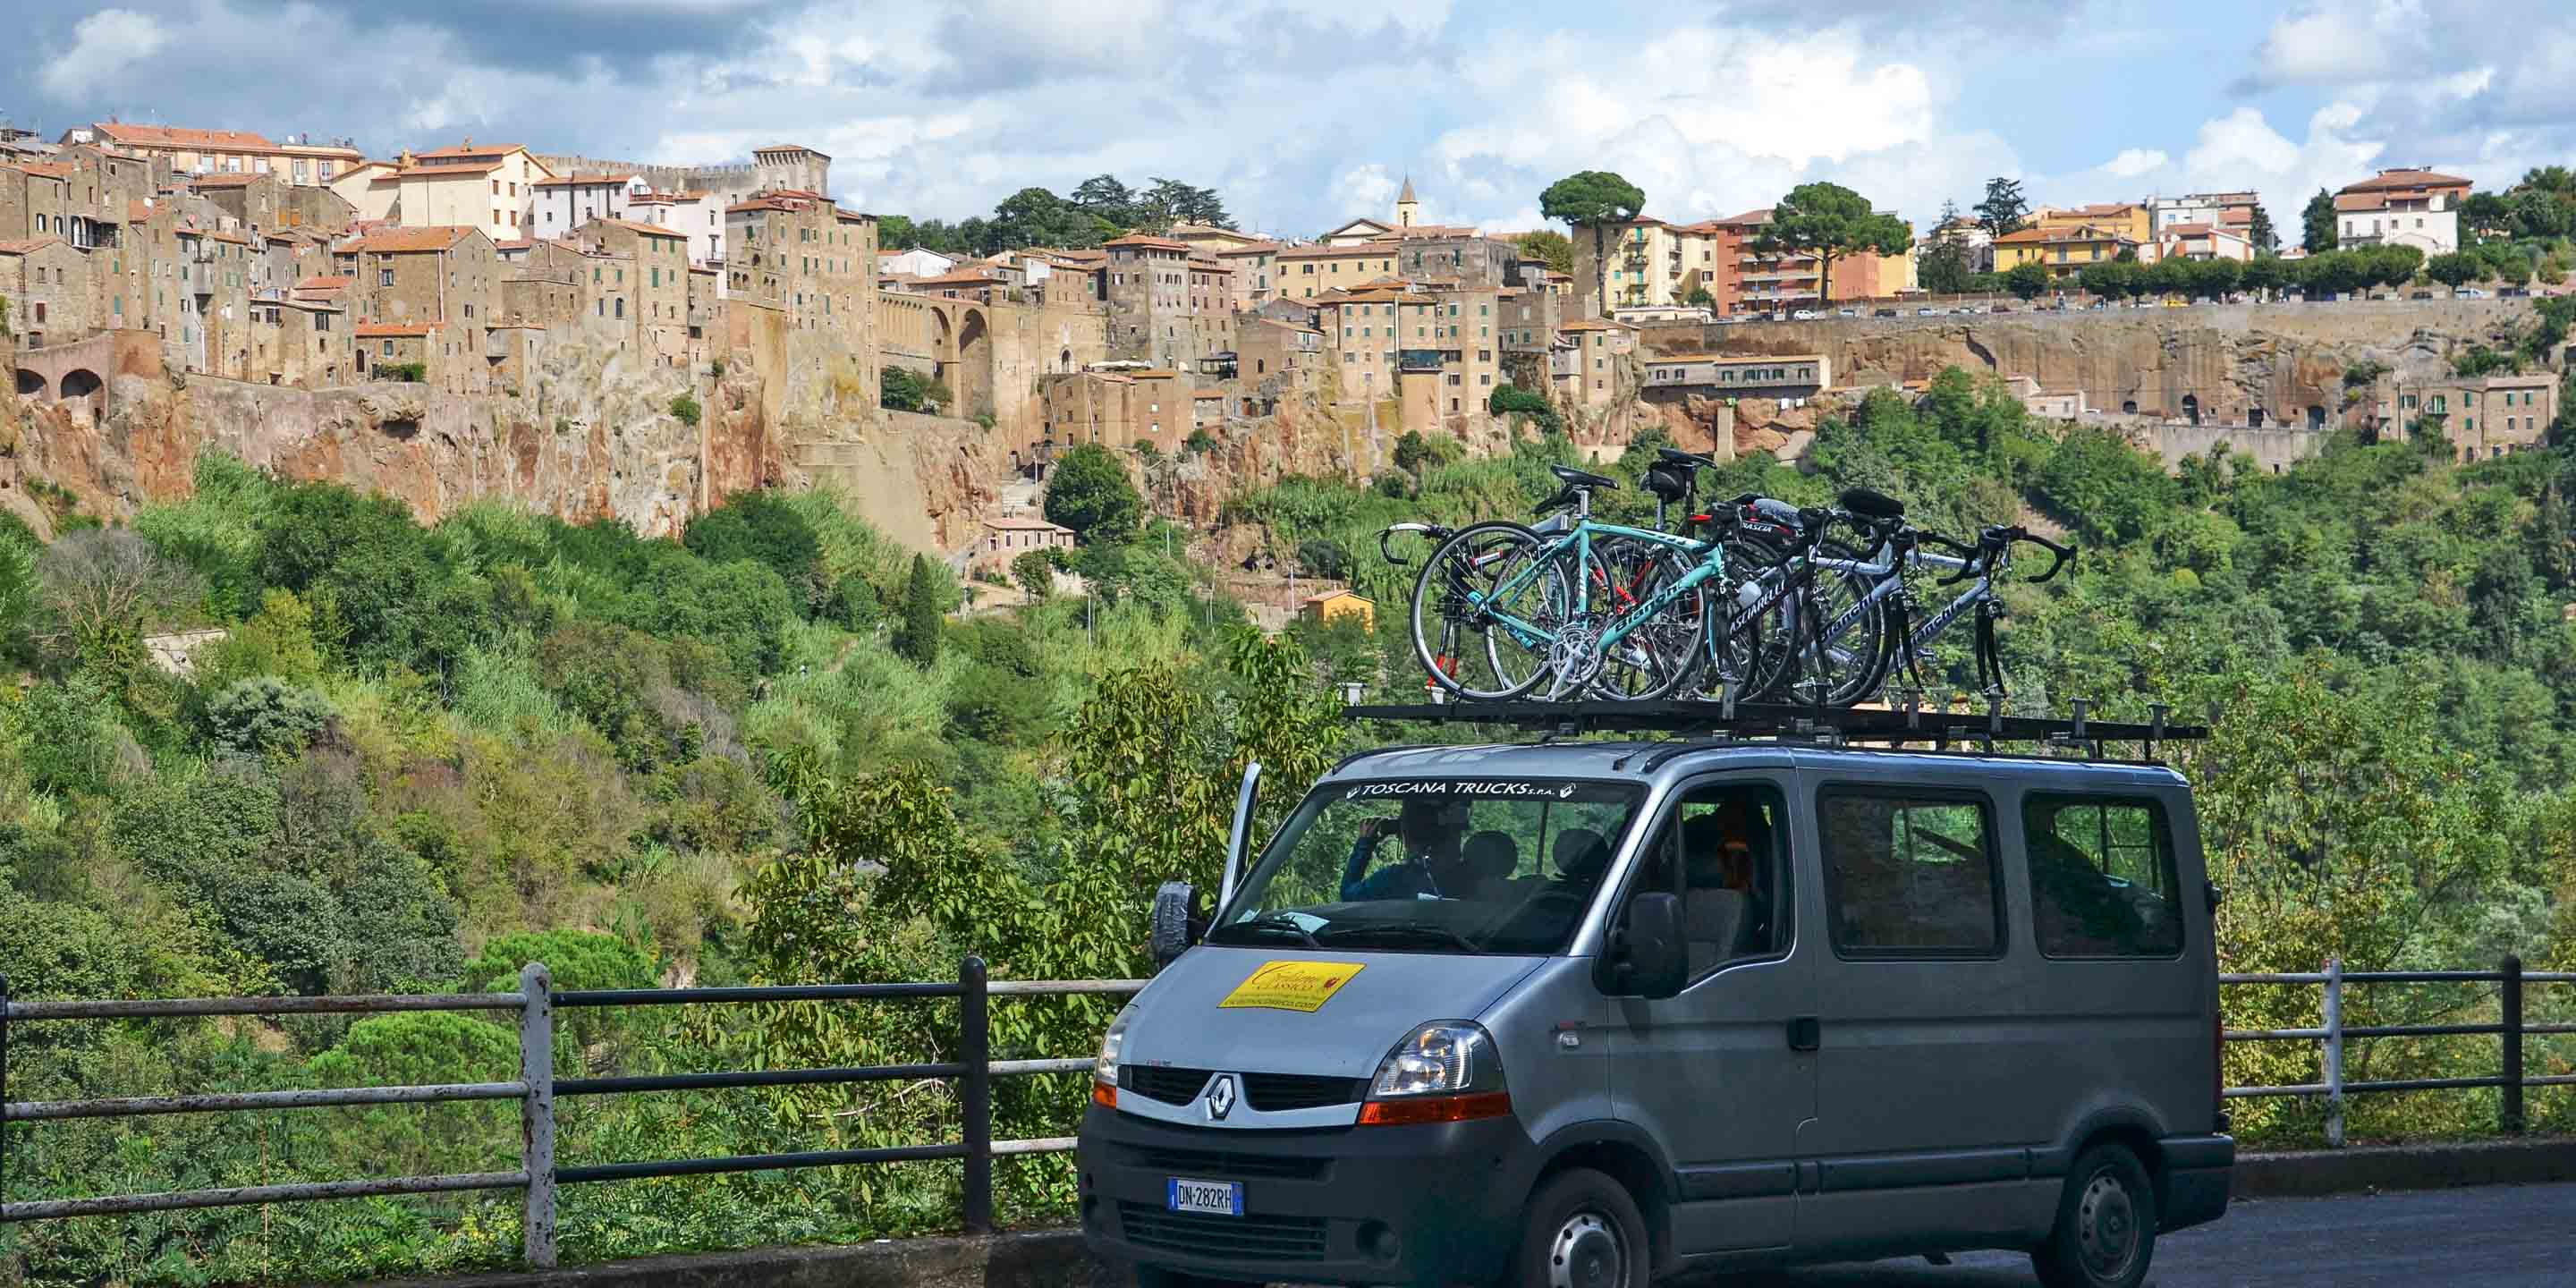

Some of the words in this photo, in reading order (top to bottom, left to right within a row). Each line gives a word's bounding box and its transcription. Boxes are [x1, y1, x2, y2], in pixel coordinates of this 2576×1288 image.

[1615, 579, 1682, 631] Bianchi
[1729, 579, 1785, 635] ASCIARELLI
[1362, 782, 1446, 795] TOSCANA
[1453, 782, 1530, 795] TRUCKS
